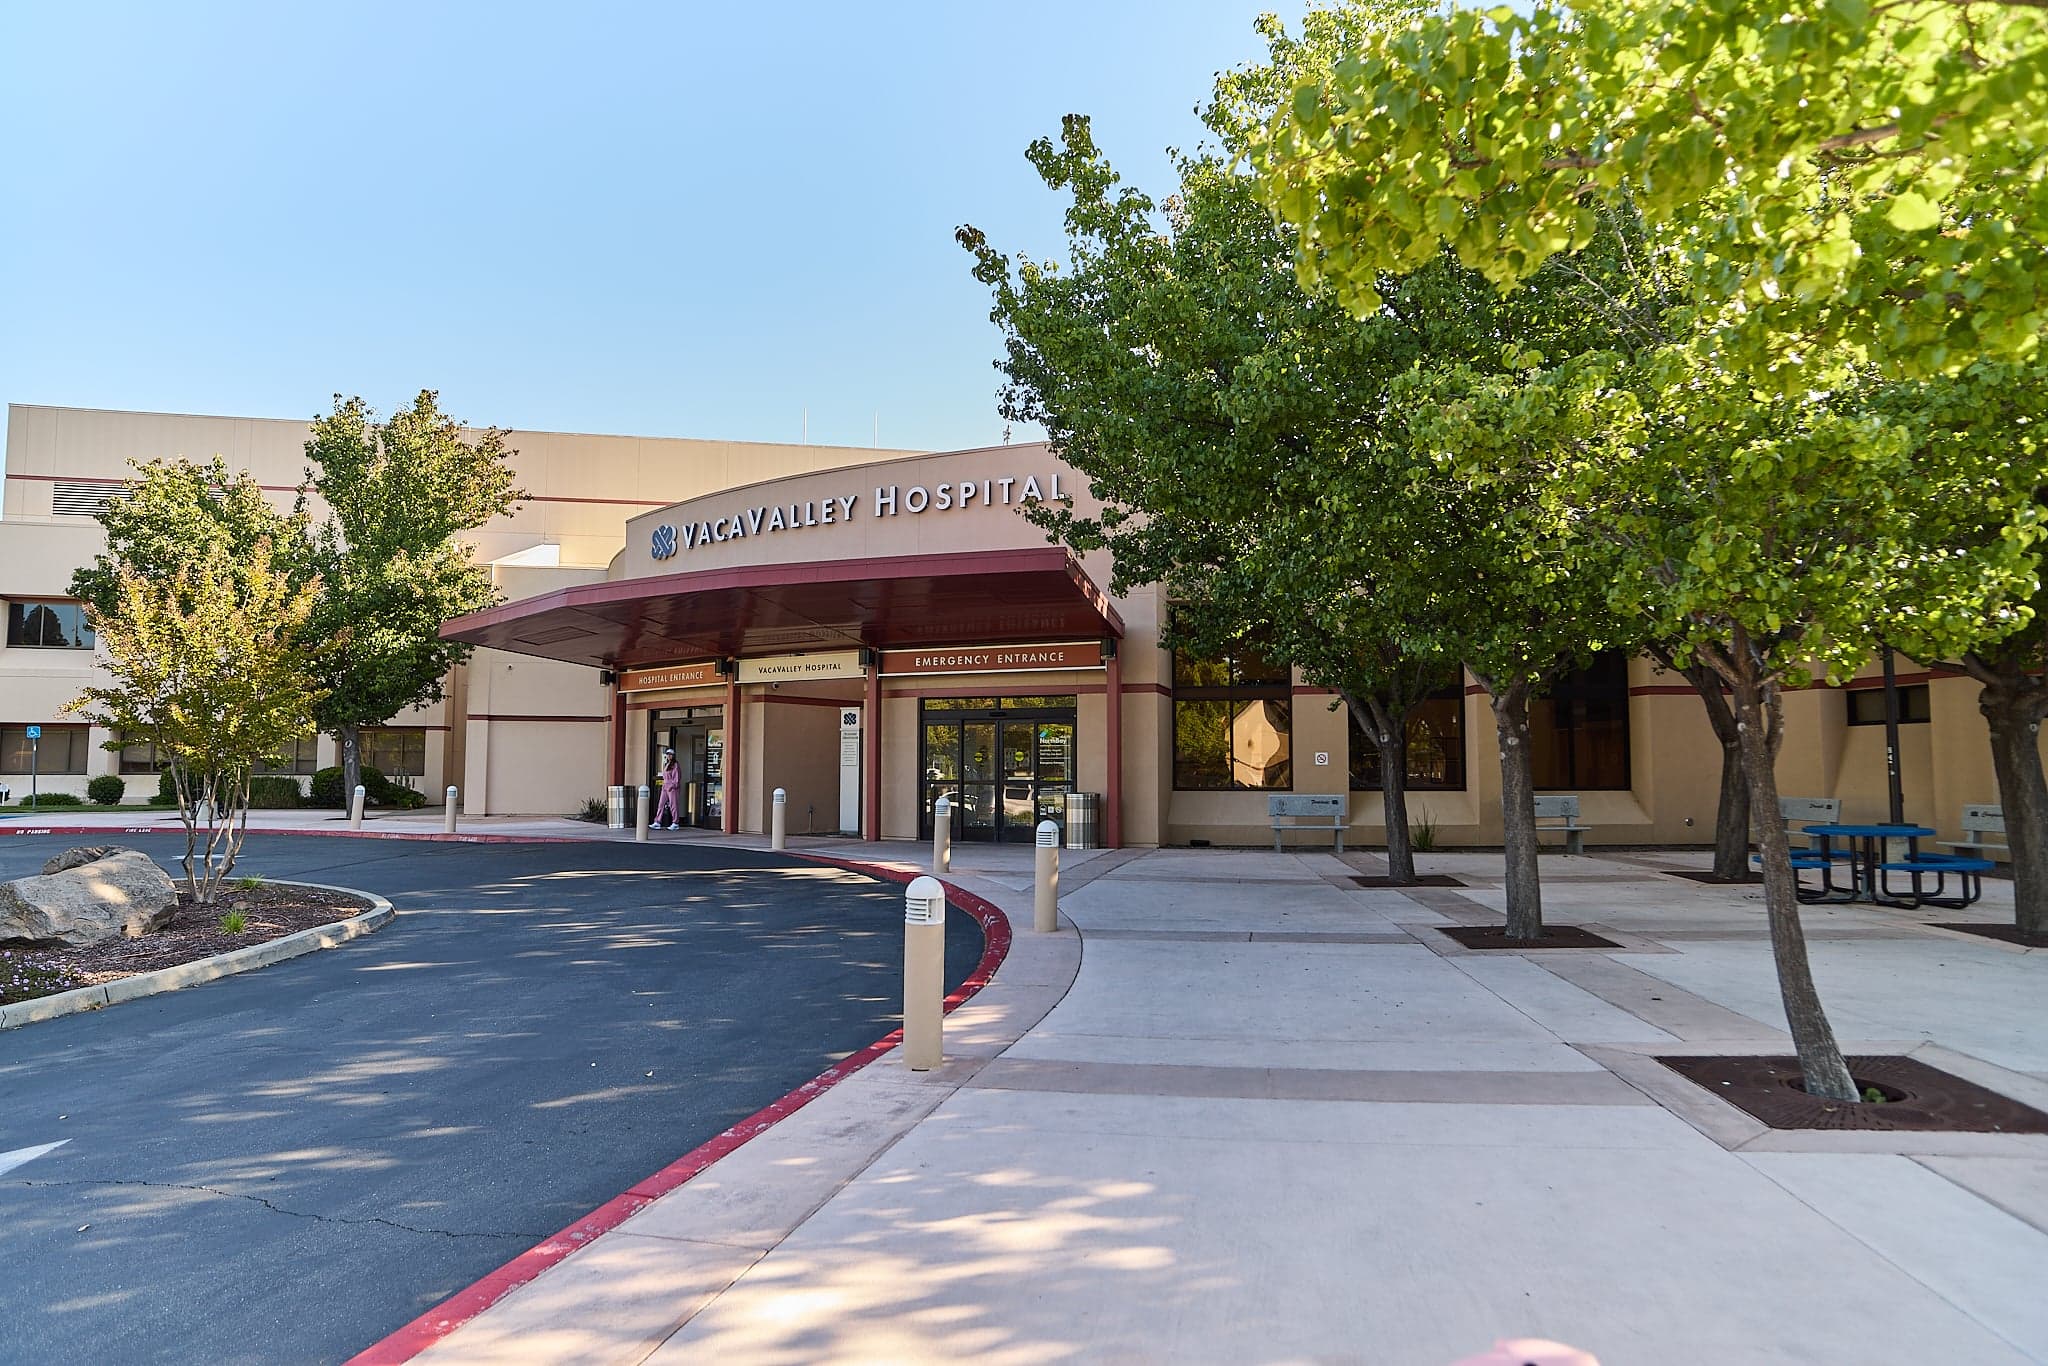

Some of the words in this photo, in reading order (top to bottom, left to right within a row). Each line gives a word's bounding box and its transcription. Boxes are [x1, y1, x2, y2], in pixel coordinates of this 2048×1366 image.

[682, 495, 857, 549] VACAVALLEY
[874, 473, 1066, 517] HOSPITAL
[915, 654, 989, 667] EMERGENCY
[997, 652, 1064, 663] ENTRANCE
[759, 665, 801, 674] VACAVALLEY
[805, 663, 842, 671] HOSPITAL
[639, 675, 668, 684] HOSPITAL
[670, 671, 704, 681] ENTRANCE
